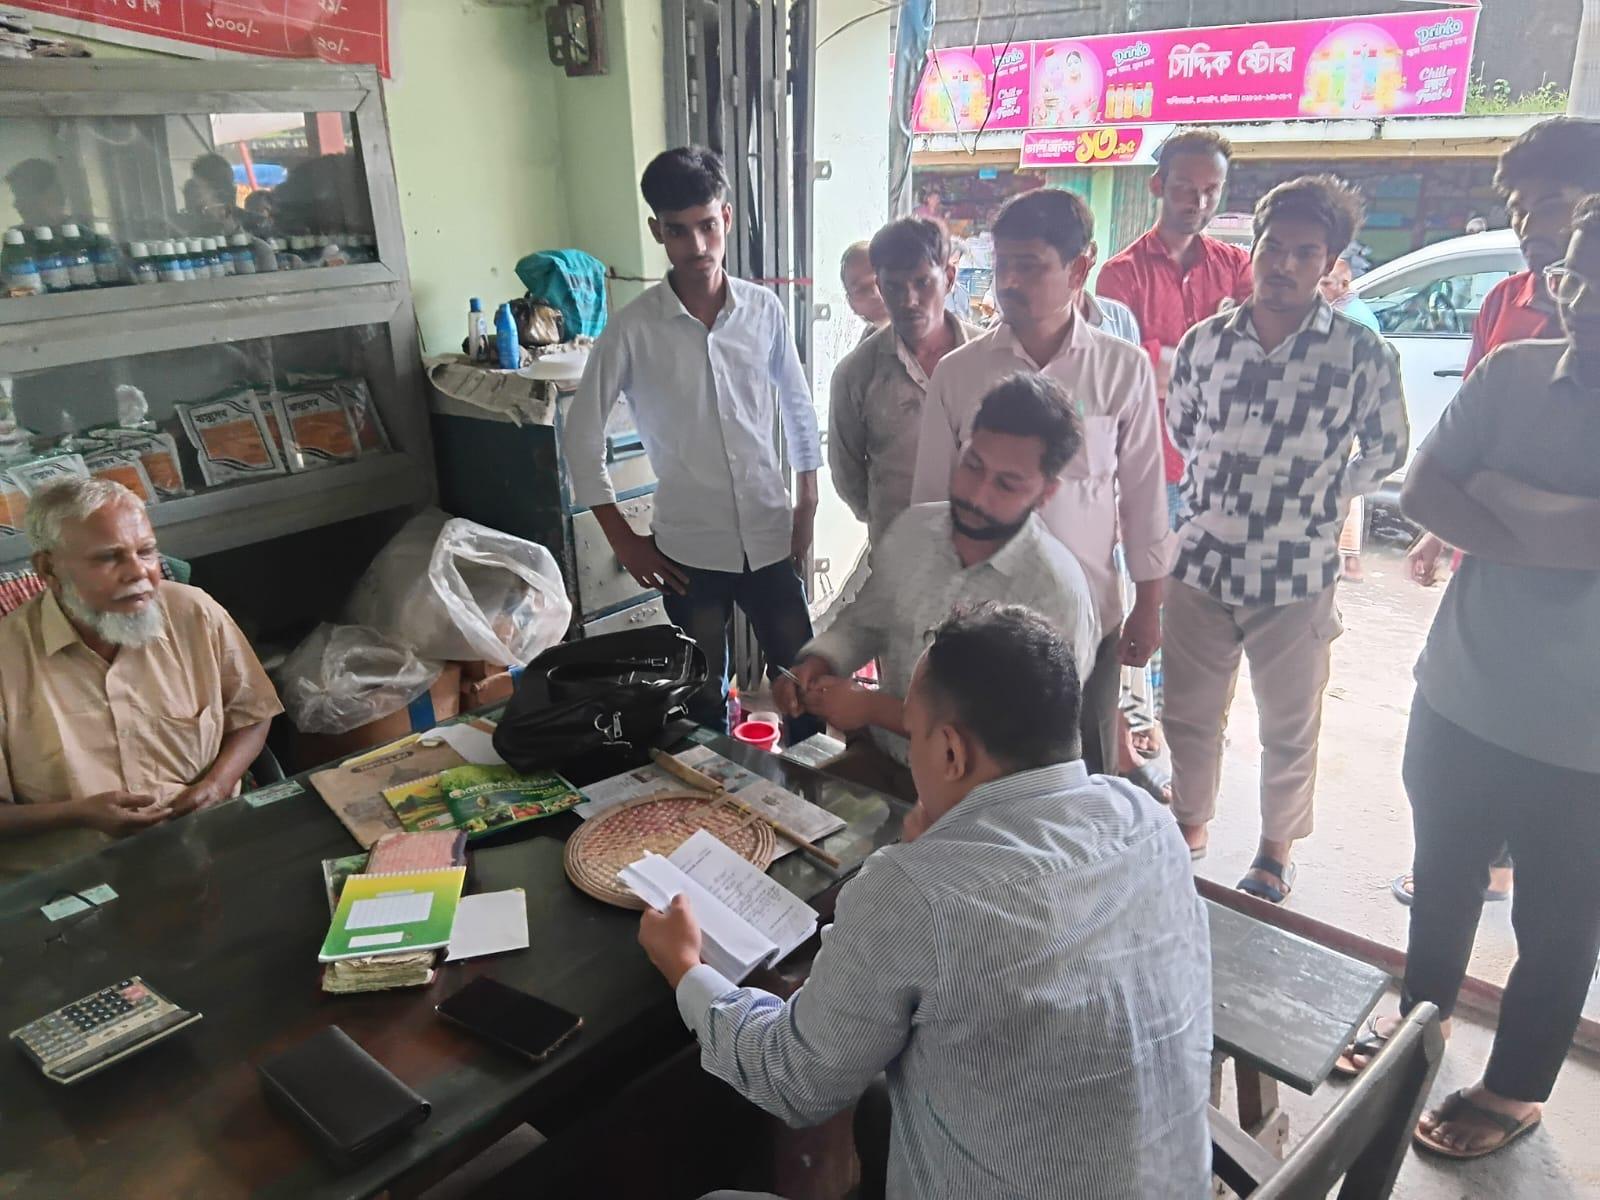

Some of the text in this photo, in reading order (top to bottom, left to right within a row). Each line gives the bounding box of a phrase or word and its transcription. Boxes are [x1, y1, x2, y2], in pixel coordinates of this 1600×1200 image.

[206, 12, 260, 38] ১০০০/-
[1415, 17, 1463, 45] Drinko
[1112, 41, 1151, 66] Drinko
